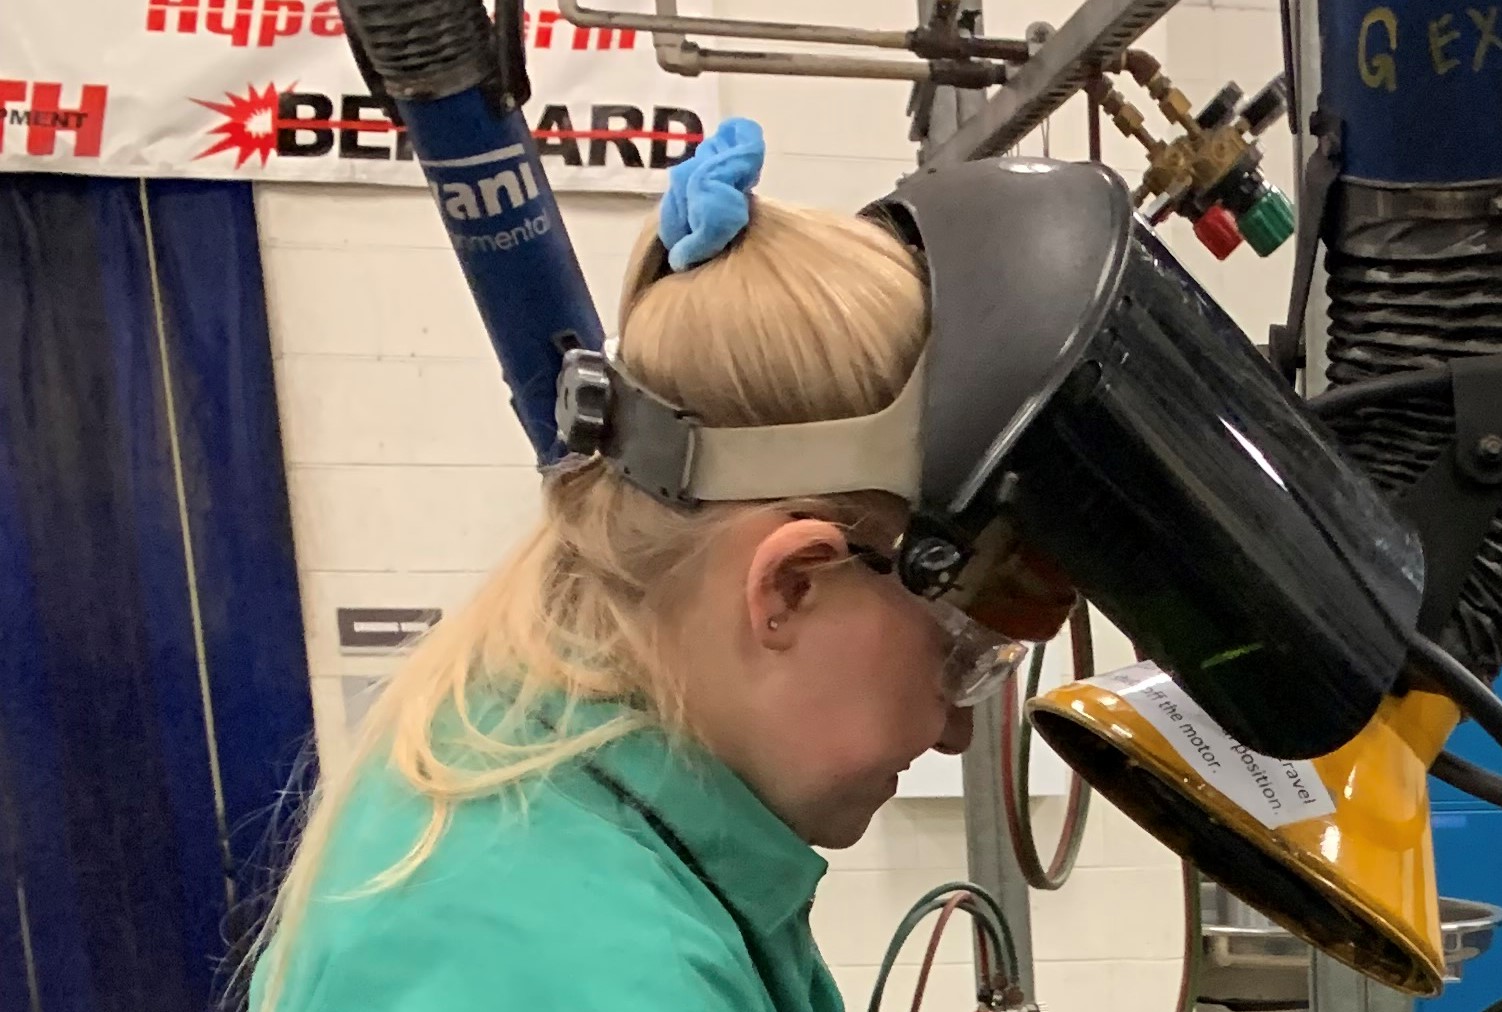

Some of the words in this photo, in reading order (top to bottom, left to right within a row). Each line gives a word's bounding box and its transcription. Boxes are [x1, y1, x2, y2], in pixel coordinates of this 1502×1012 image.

[1358, 6, 1398, 92] G
[277, 93, 704, 169] BEARD
[1158, 700, 1184, 722] the
[1179, 722, 1222, 775] motor.
[1230, 744, 1282, 815] position.
[1279, 759, 1317, 804] ravel
